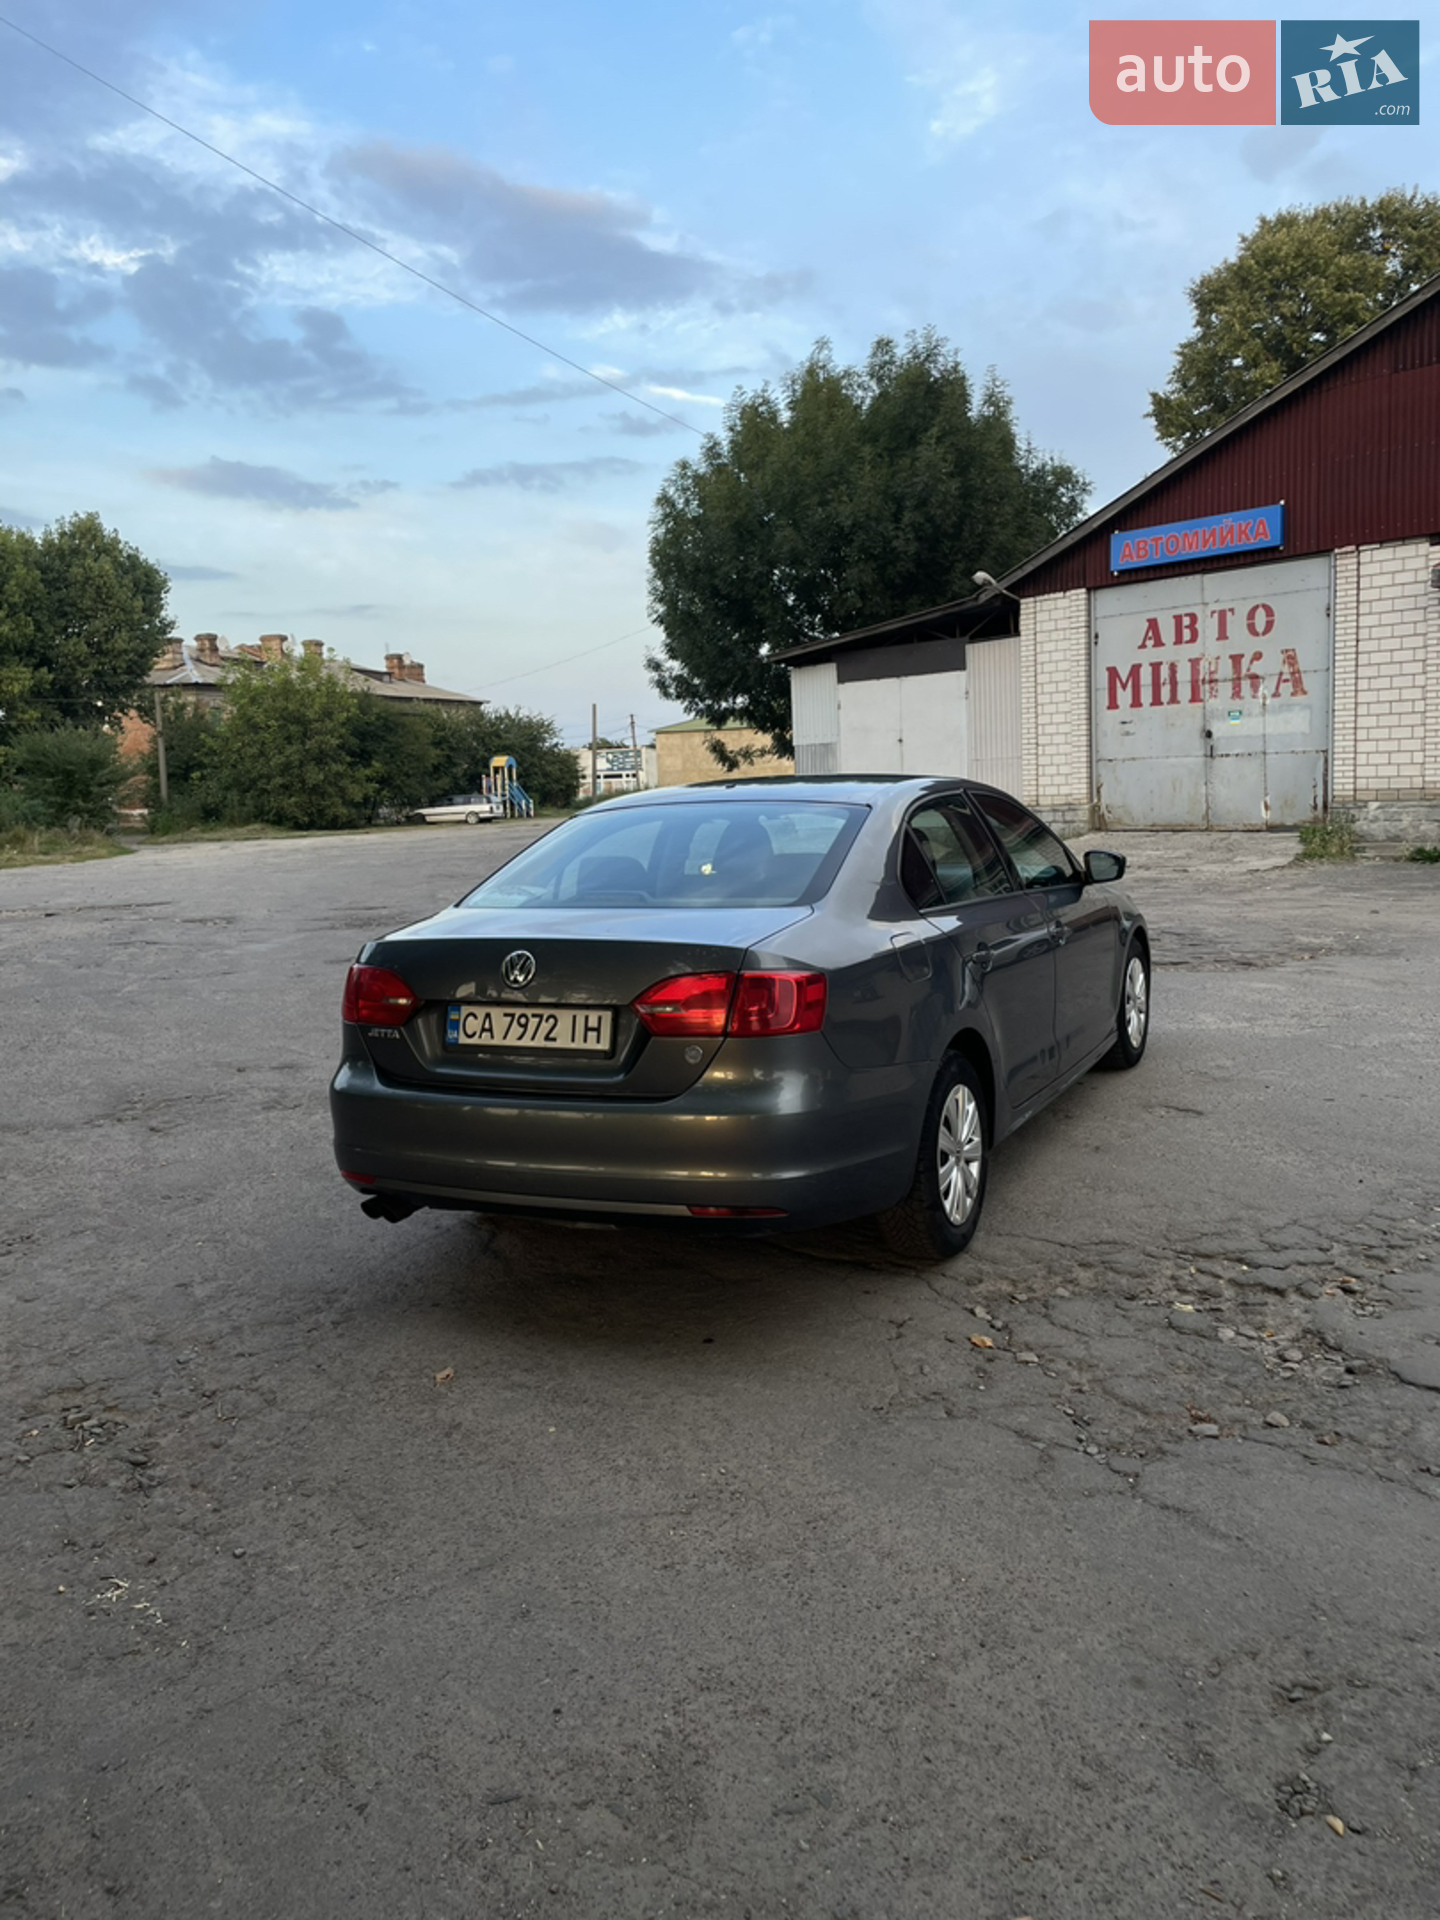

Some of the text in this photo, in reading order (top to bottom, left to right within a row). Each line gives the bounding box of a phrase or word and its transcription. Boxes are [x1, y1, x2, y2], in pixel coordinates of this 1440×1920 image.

[1119, 517, 1271, 564] АВТОМИЙКА
[1137, 603, 1276, 650] АВТО
[367, 1027, 400, 1039] JETTA
[461, 1011, 602, 1045] CA 7972 IH
